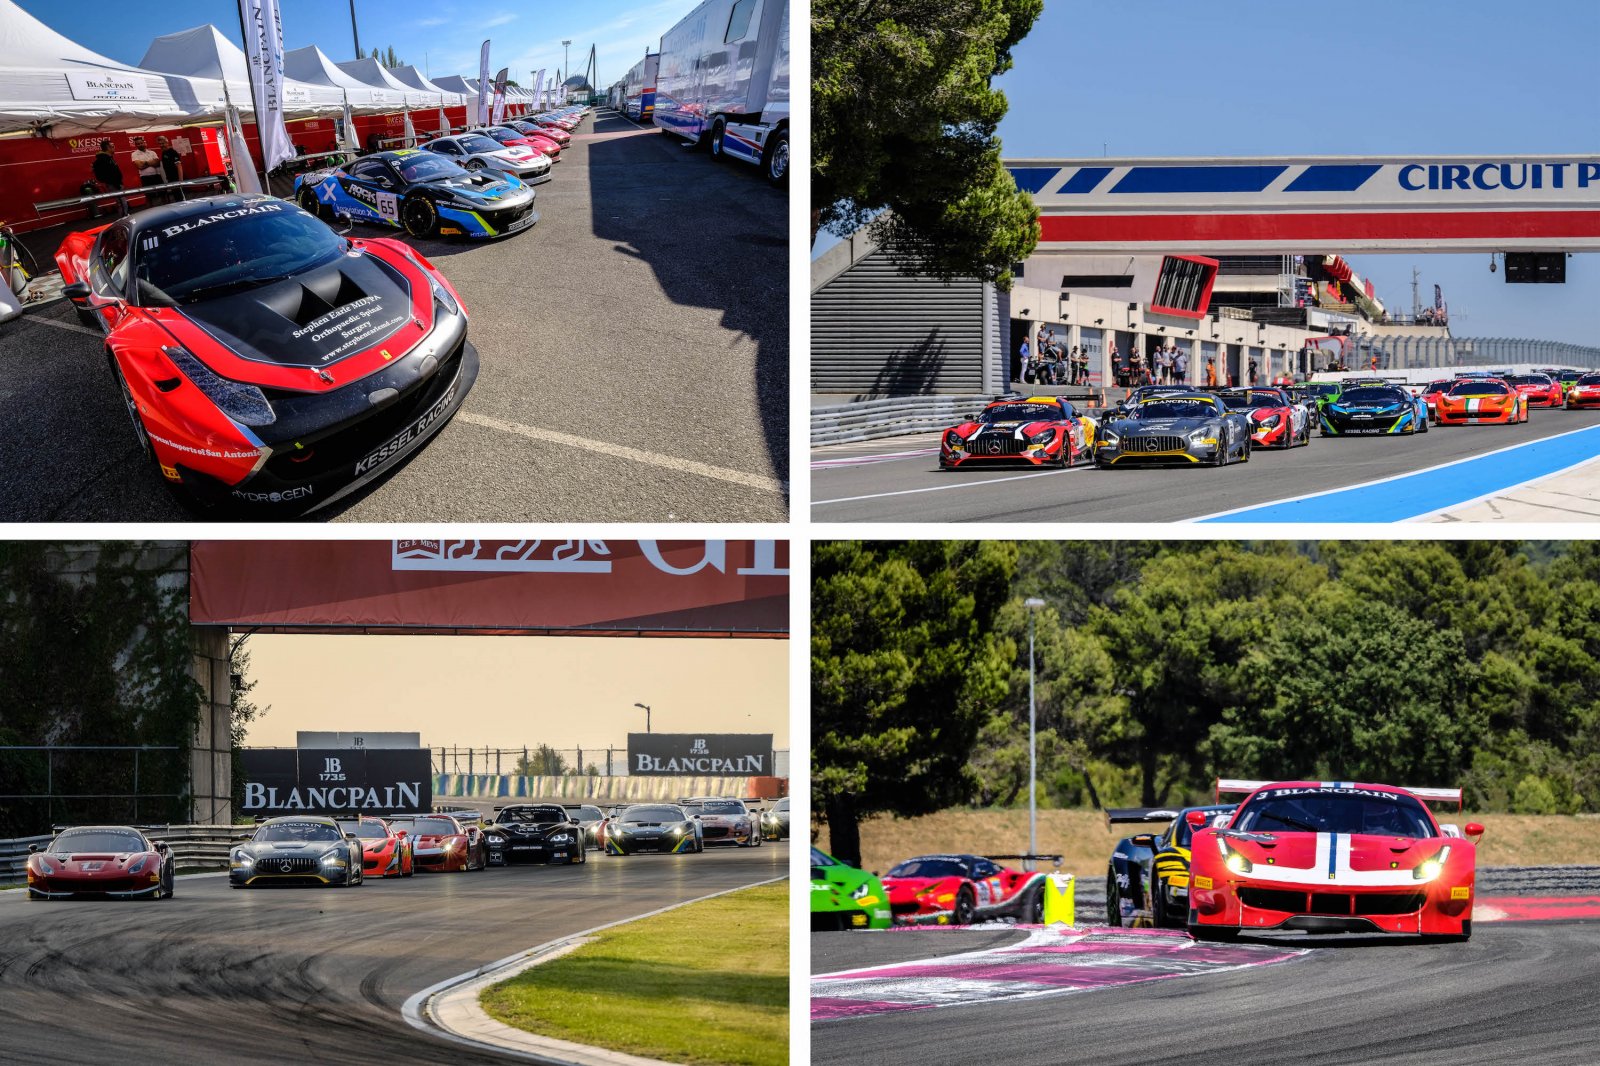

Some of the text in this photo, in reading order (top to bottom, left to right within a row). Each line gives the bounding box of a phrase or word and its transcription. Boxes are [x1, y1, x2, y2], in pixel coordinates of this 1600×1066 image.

[252, 6, 278, 112] BLANCPAIN
[86, 80, 134, 89] BLANCPAIN
[1397, 162, 1571, 191] CIRCUIT
[161, 203, 283, 239] BLANCPAIN
[380, 199, 395, 215] 65
[292, 315, 330, 339] Stephen
[328, 306, 352, 320] Earle
[311, 304, 383, 342] Orthopaedic Spinal
[341, 320, 372, 339] Surgery
[321, 315, 404, 361] www.stephenearlemd.com
[354, 387, 455, 476] KESSEL RACING
[205, 449, 222, 458] San
[223, 449, 263, 459] Antonio
[319, 773, 347, 781] 1735
[635, 753, 765, 773] BLANCPAIN
[242, 781, 422, 809] BLANCPAIN
[1274, 787, 1398, 800] BLANCPAIN
